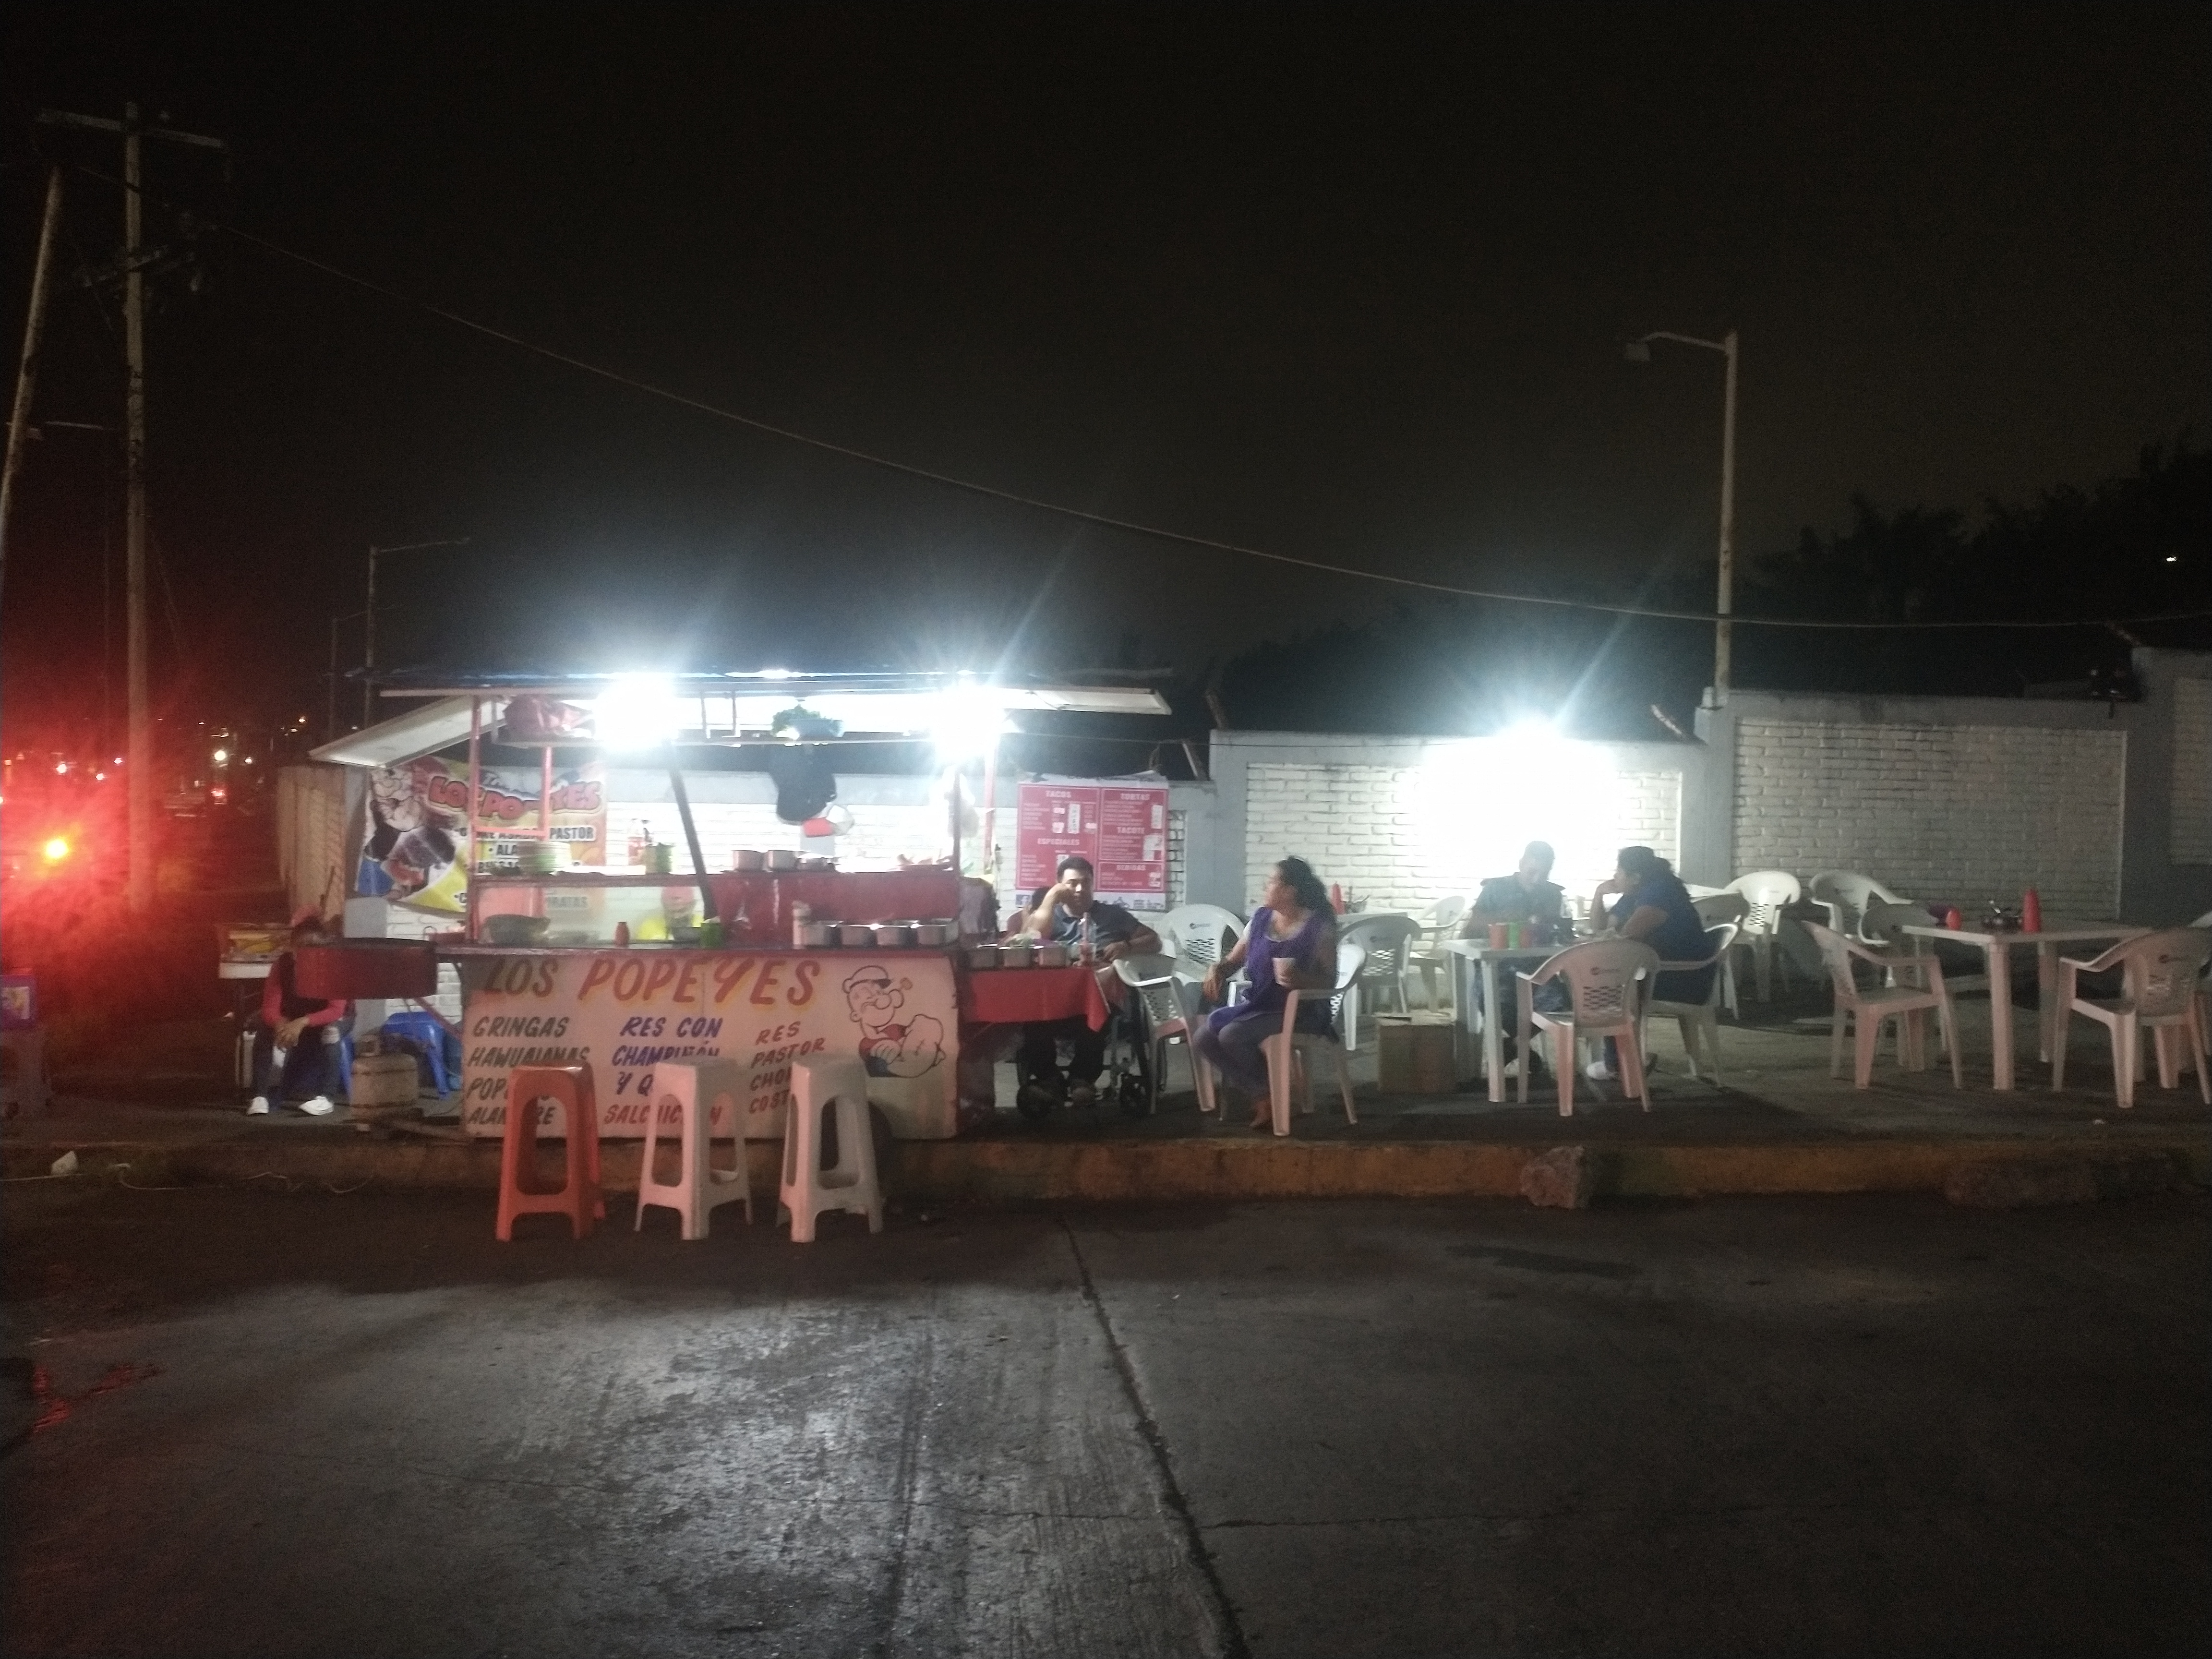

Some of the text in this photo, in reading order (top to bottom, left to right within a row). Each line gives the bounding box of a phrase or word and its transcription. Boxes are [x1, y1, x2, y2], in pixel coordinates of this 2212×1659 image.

[549, 827, 594, 840] PASTOR
[482, 957, 820, 1006] LOS POPEYES
[472, 1016, 570, 1038] GRINGAS
[619, 1016, 723, 1038] RES CON
[755, 1021, 801, 1046] RES
[750, 1037, 825, 1070] PASTOR
[615, 1071, 633, 1095] Y
